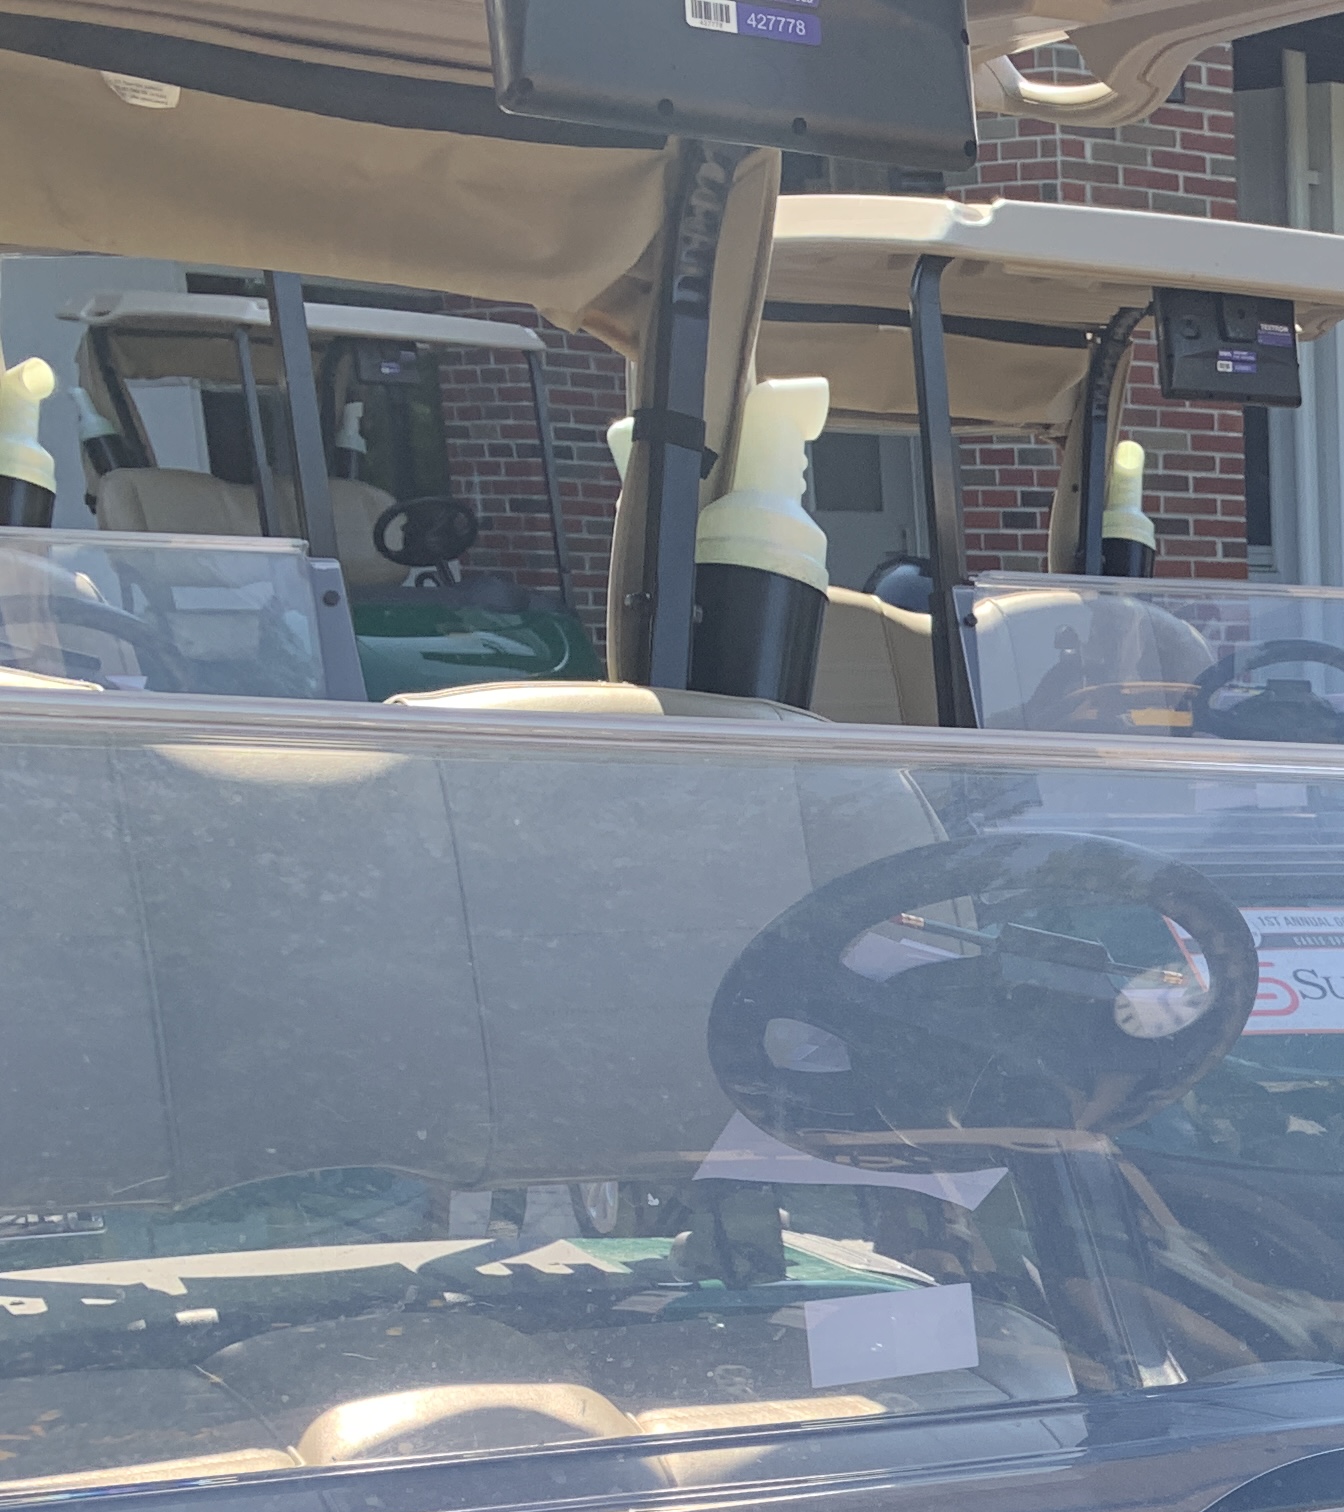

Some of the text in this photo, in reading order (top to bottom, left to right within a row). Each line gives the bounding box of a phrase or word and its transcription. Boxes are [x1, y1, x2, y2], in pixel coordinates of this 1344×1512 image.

[746, 13, 806, 36] 427778
[1257, 916, 1282, 927] 1ST
[1283, 916, 1332, 928] ANNUAL
